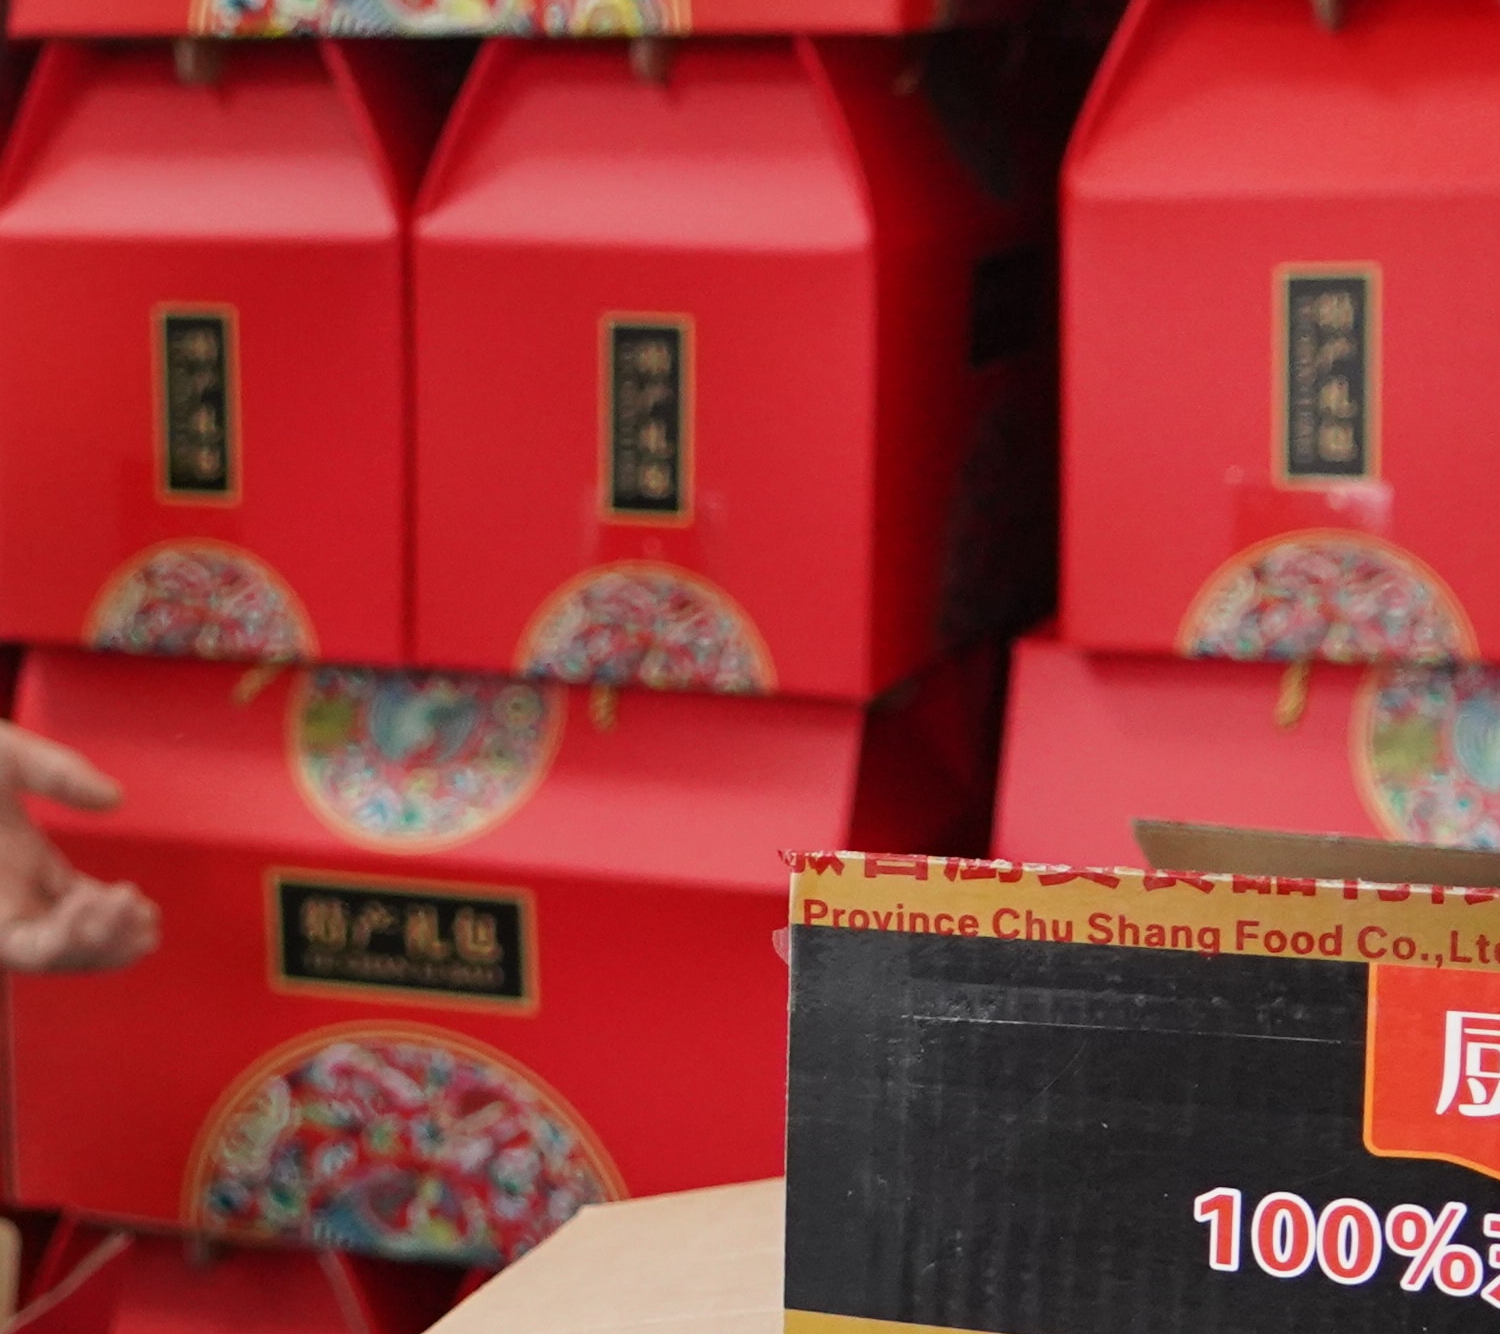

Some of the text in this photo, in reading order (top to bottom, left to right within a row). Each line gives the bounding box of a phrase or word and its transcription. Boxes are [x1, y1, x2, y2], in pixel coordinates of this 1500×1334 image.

[803, 898, 979, 938] Province
[991, 908, 1074, 944] Chu
[1087, 912, 1221, 956] Shang
[1236, 920, 1343, 957] Food
